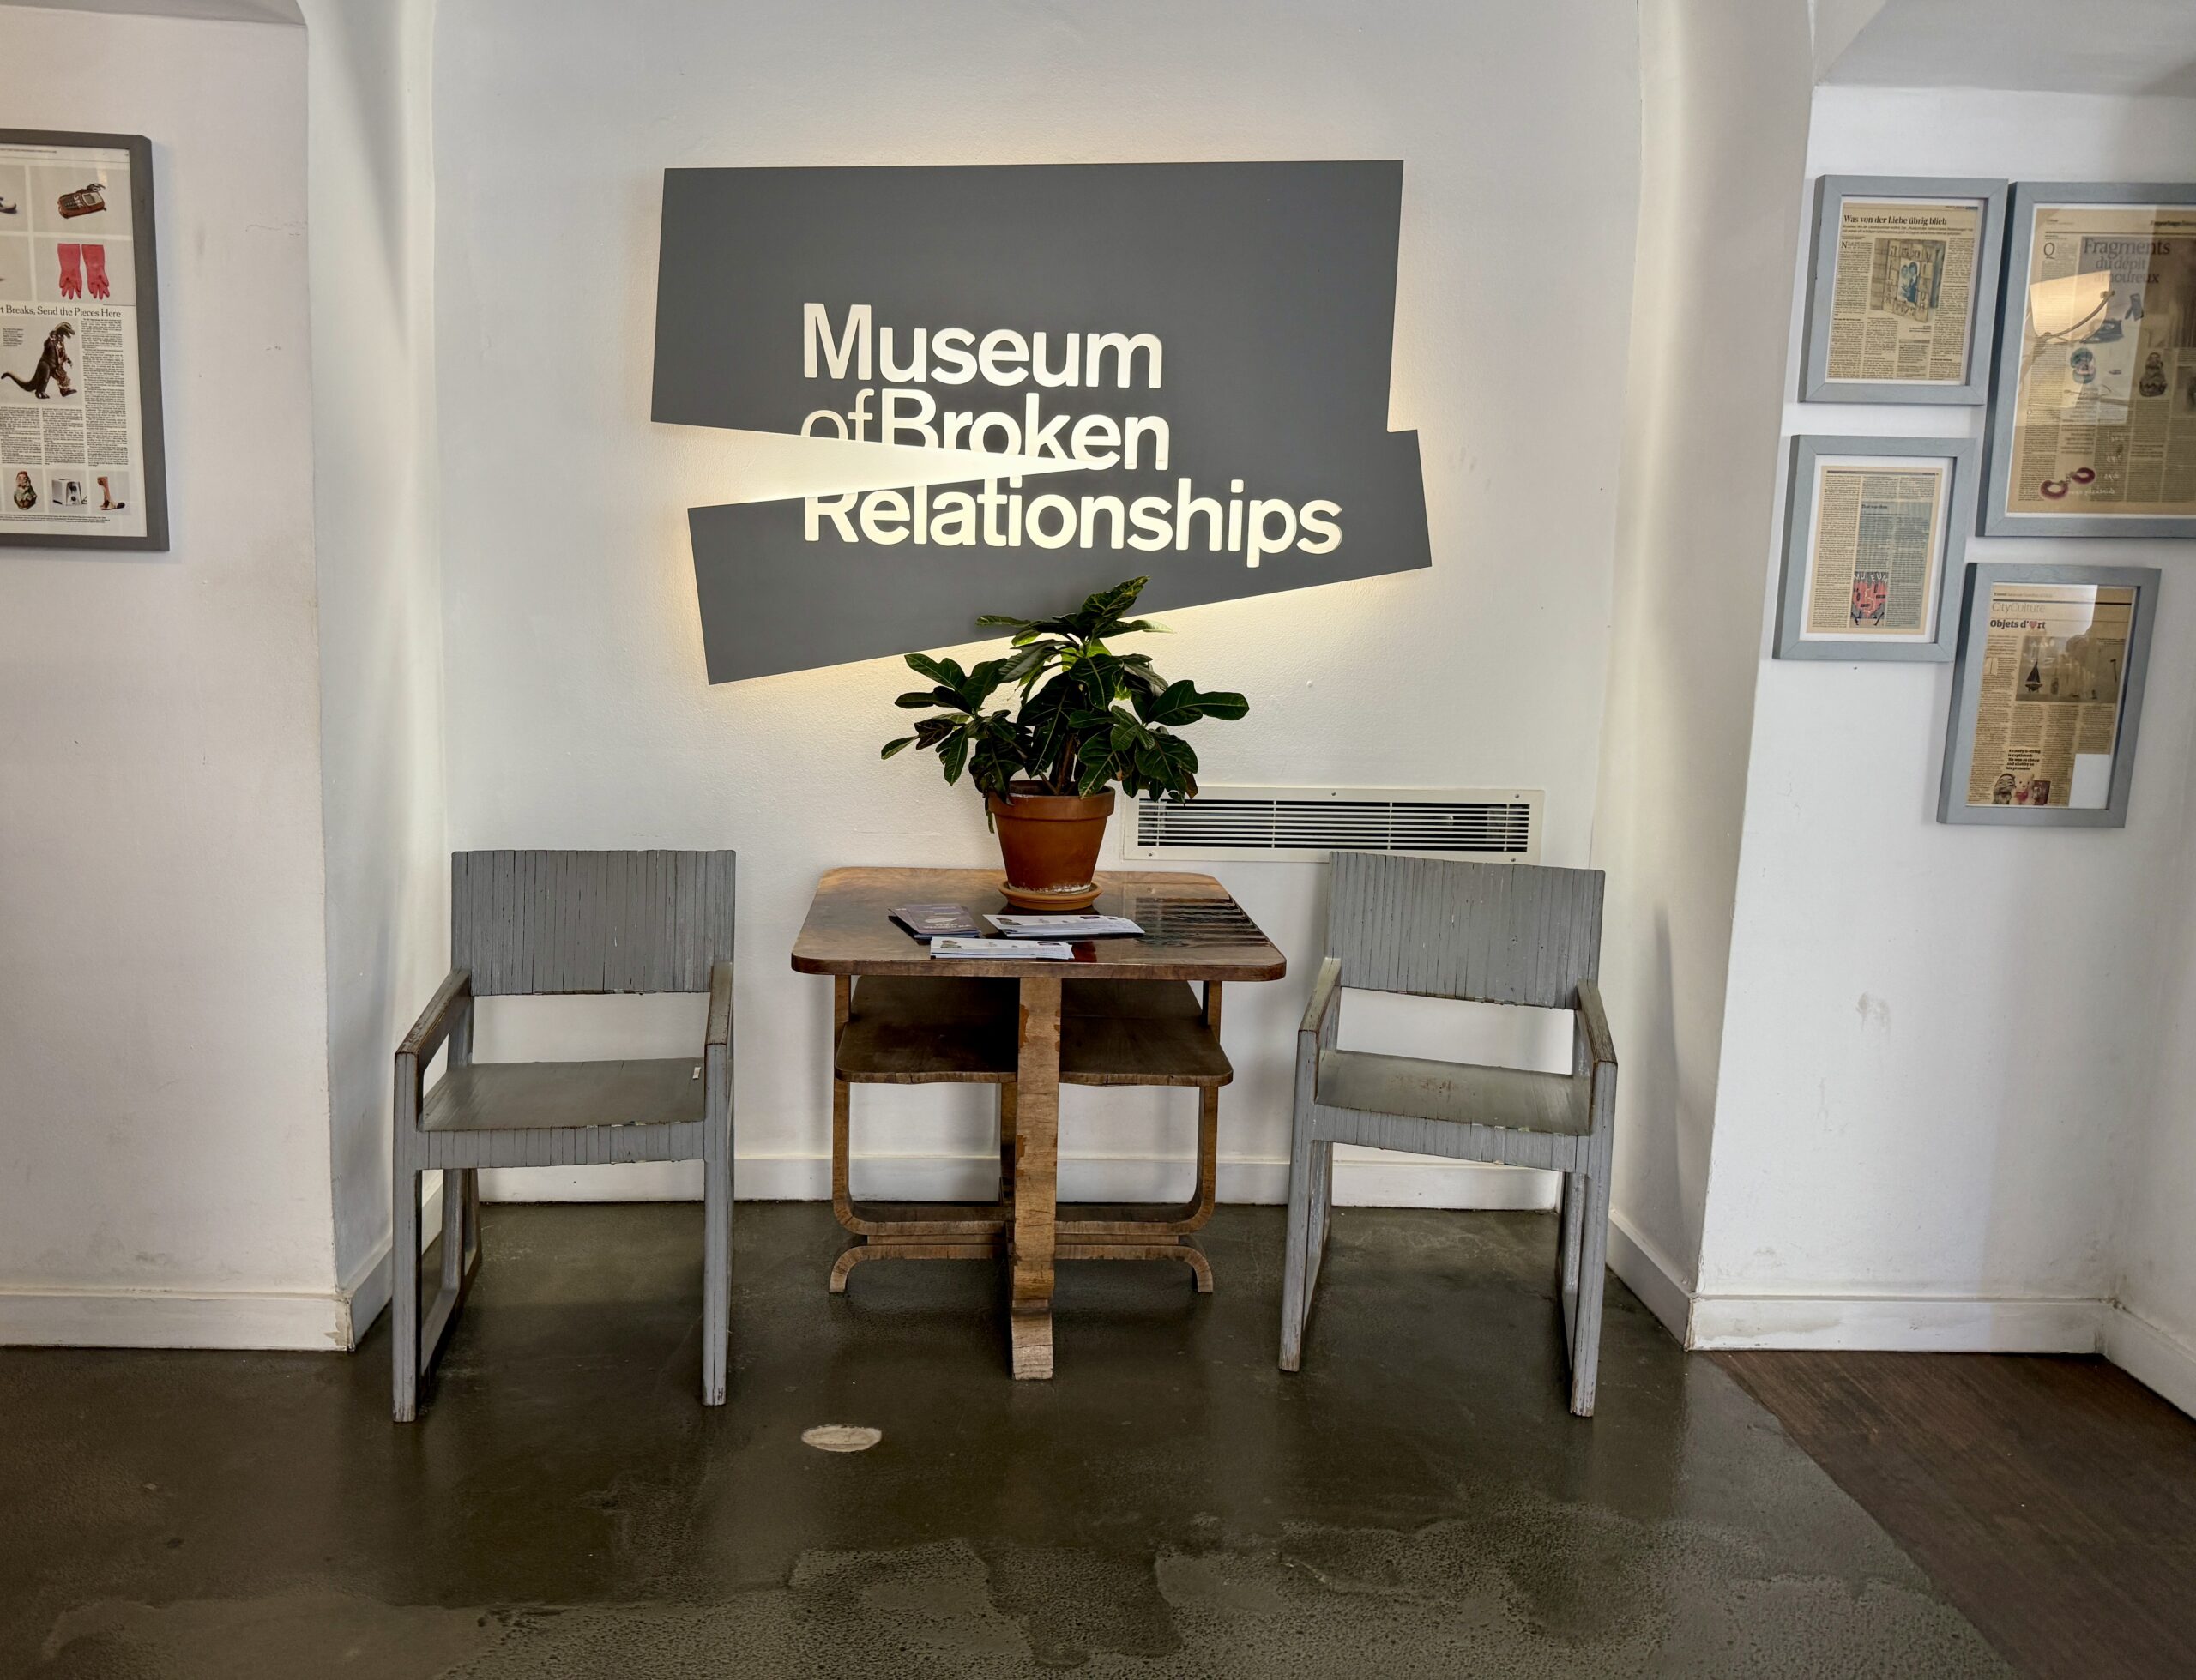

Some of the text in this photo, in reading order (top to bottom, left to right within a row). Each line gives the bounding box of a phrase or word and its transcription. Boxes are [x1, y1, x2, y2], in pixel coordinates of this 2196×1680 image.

[1874, 215, 1887, 224] der
[1888, 216, 1908, 225] Liebe
[1909, 217, 1928, 226] übrig
[2084, 238, 2171, 258] Fragments
[2096, 256, 2145, 274] du dépit
[2094, 273, 2160, 284] amoureux
[6, 304, 36, 316] Breaks,
[37, 306, 58, 316] Send
[59, 308, 73, 316] the
[74, 307, 100, 317] Pieces
[100, 309, 121, 318] Here
[803, 302, 1162, 389] Museum
[880, 388, 1170, 471] Broken
[804, 476, 1343, 569] Relationships
[1989, 619, 2019, 629] Objets
